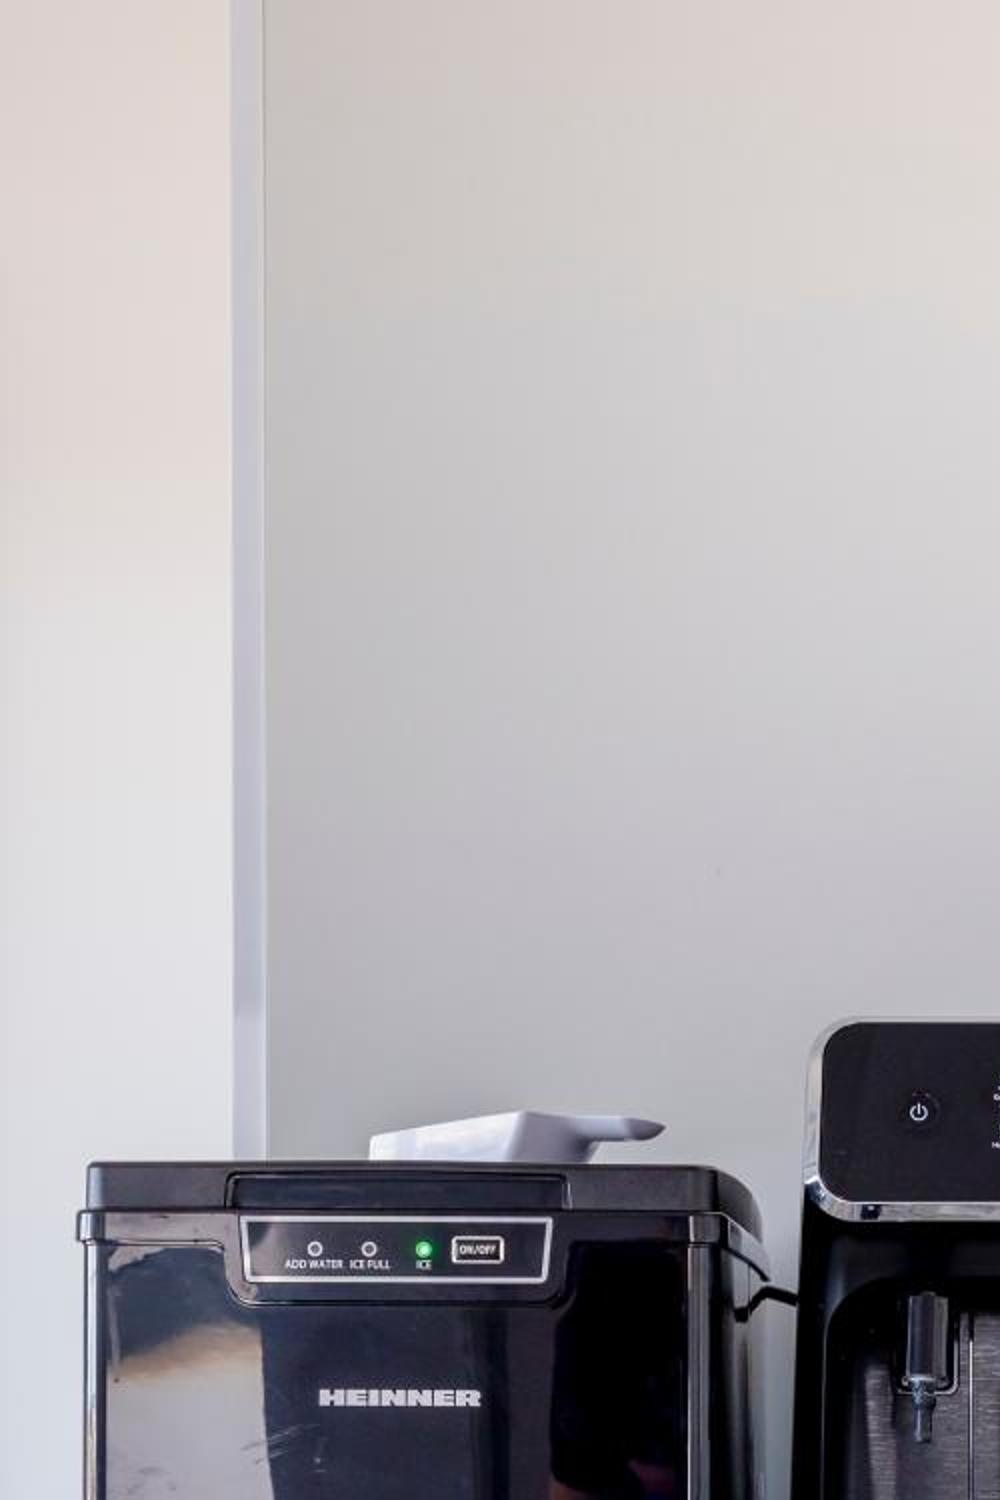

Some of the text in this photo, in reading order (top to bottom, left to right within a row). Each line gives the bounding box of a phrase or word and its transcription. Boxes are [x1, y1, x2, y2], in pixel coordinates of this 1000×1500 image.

[459, 1244, 497, 1256] ON/OFF
[285, 1259, 344, 1269] ADD WATER
[350, 1259, 391, 1269] ICE FULL
[416, 1259, 432, 1270] ICE
[319, 1388, 482, 1407] HEINNER
